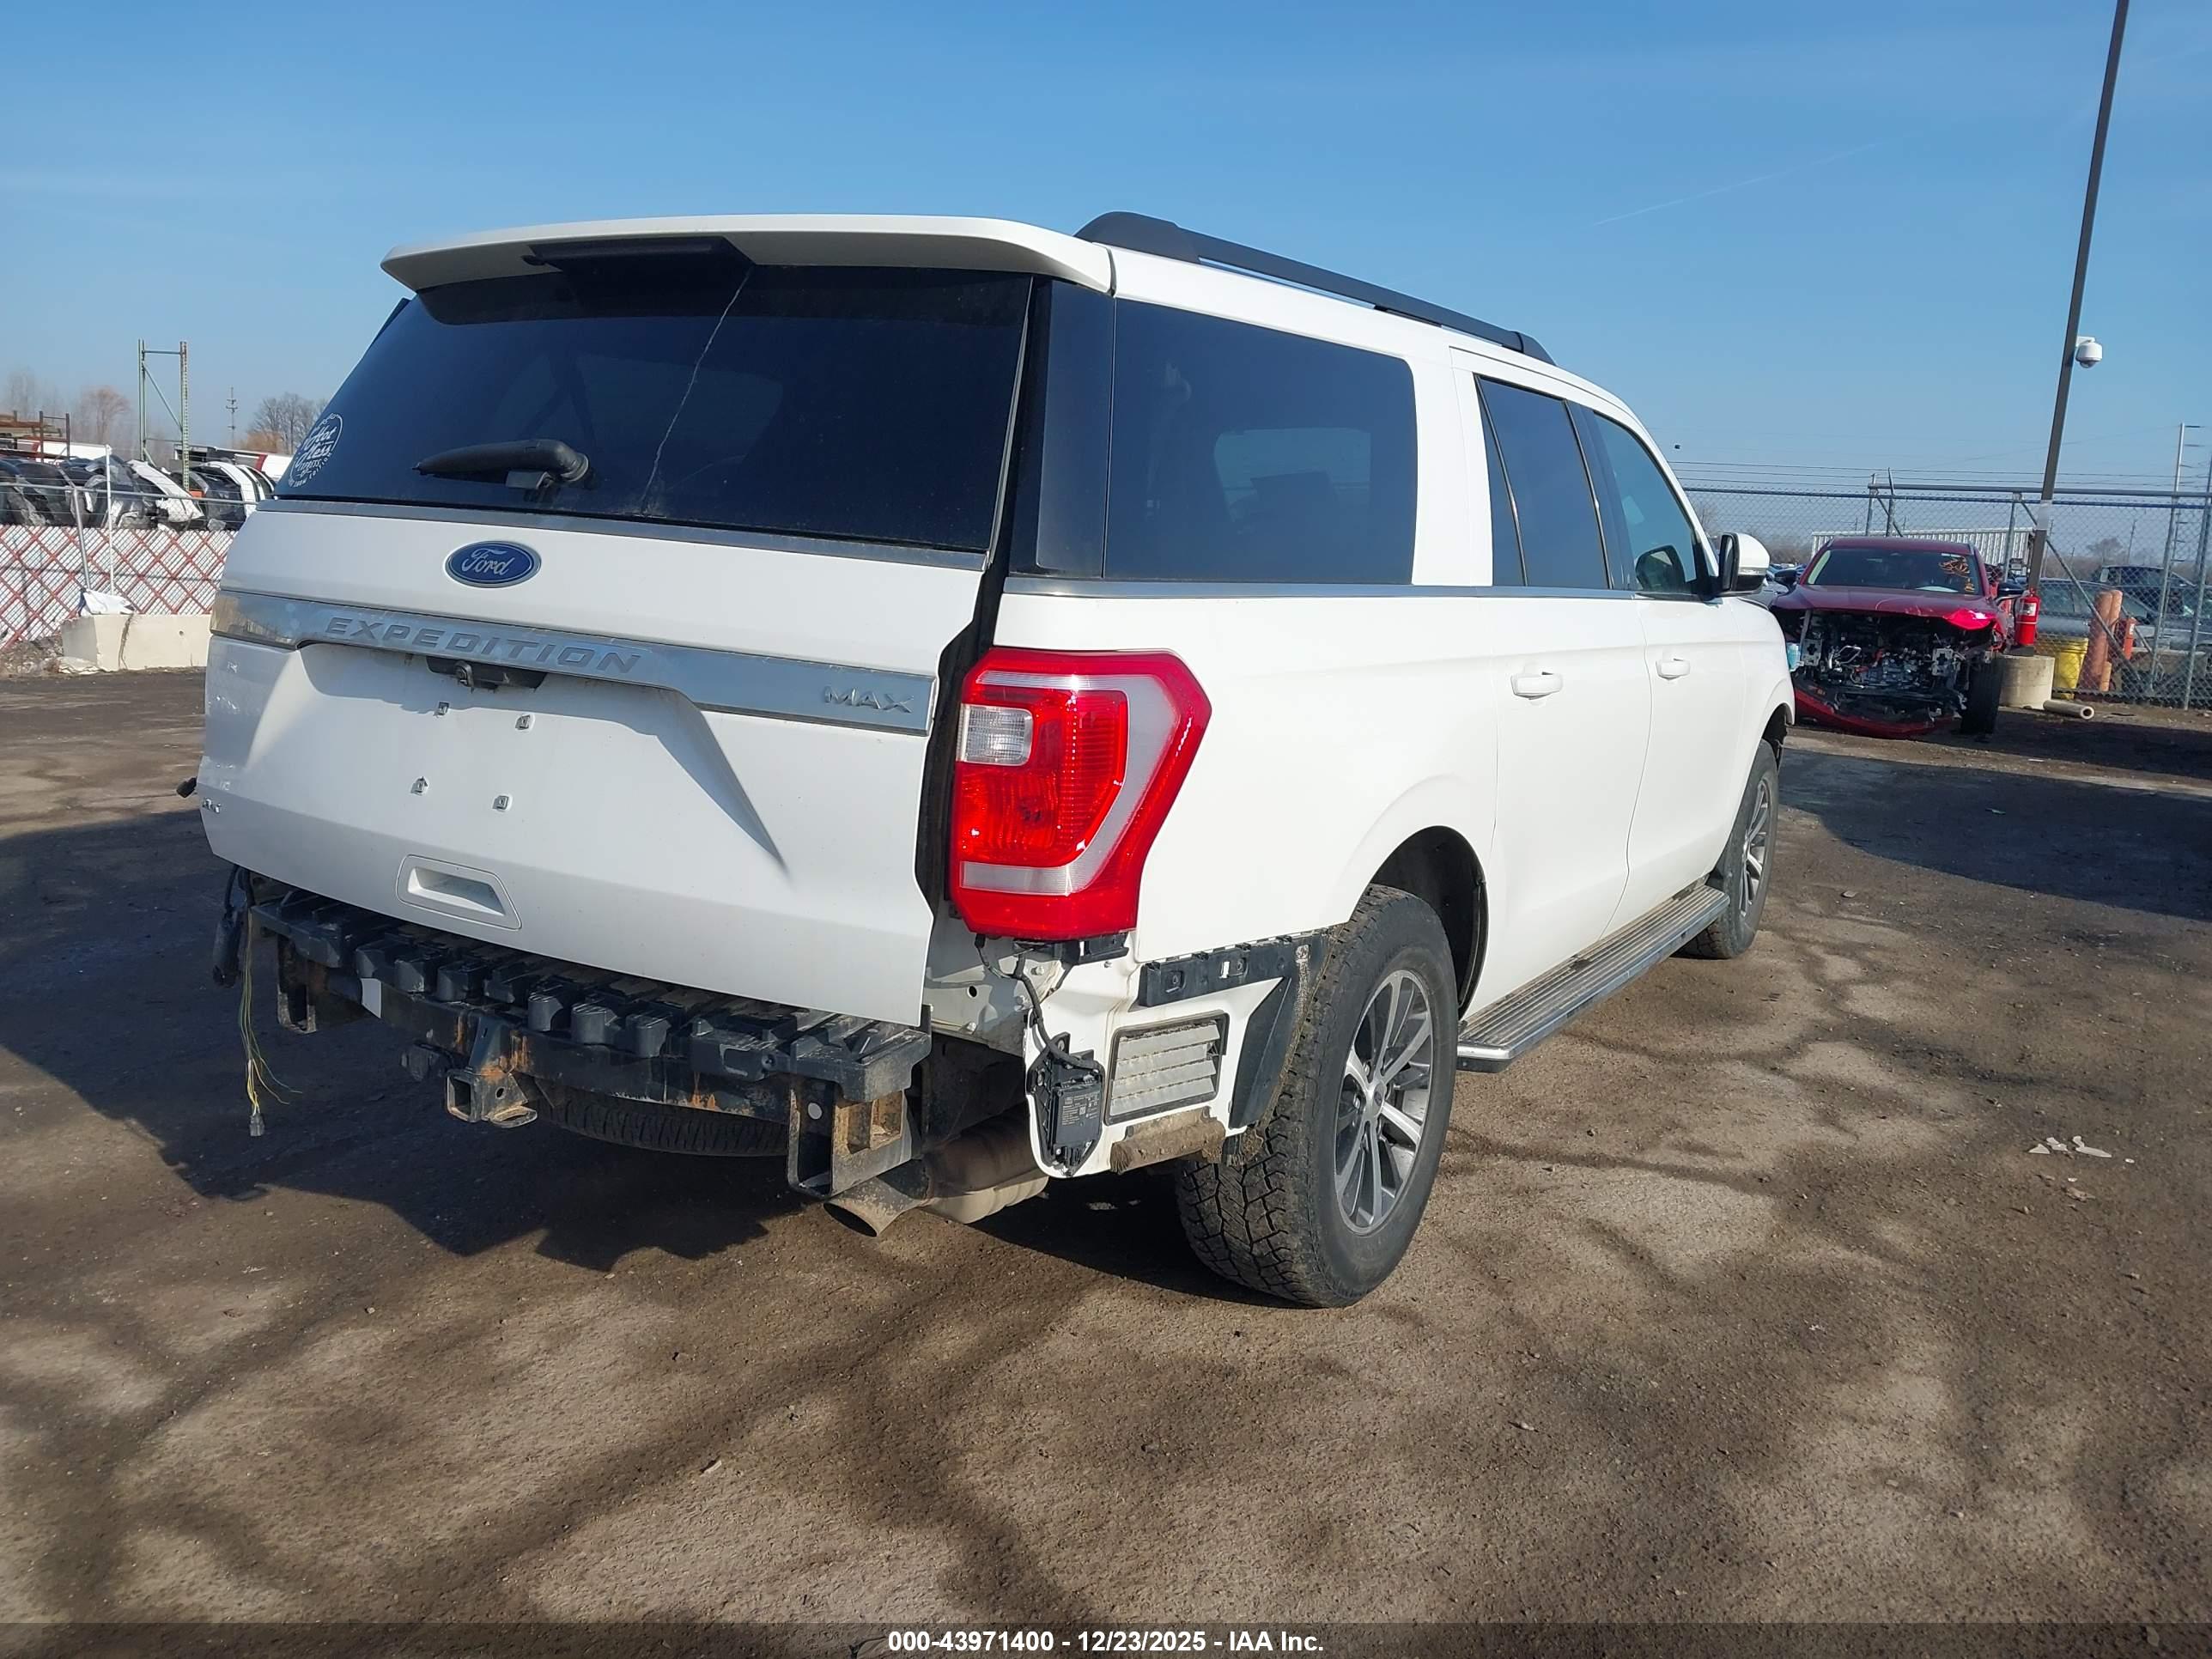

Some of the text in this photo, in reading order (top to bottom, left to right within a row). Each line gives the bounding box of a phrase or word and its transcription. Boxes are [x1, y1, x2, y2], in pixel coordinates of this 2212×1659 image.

[461, 548, 515, 575] Ford
[325, 616, 915, 714] EXPEDITION MAX
